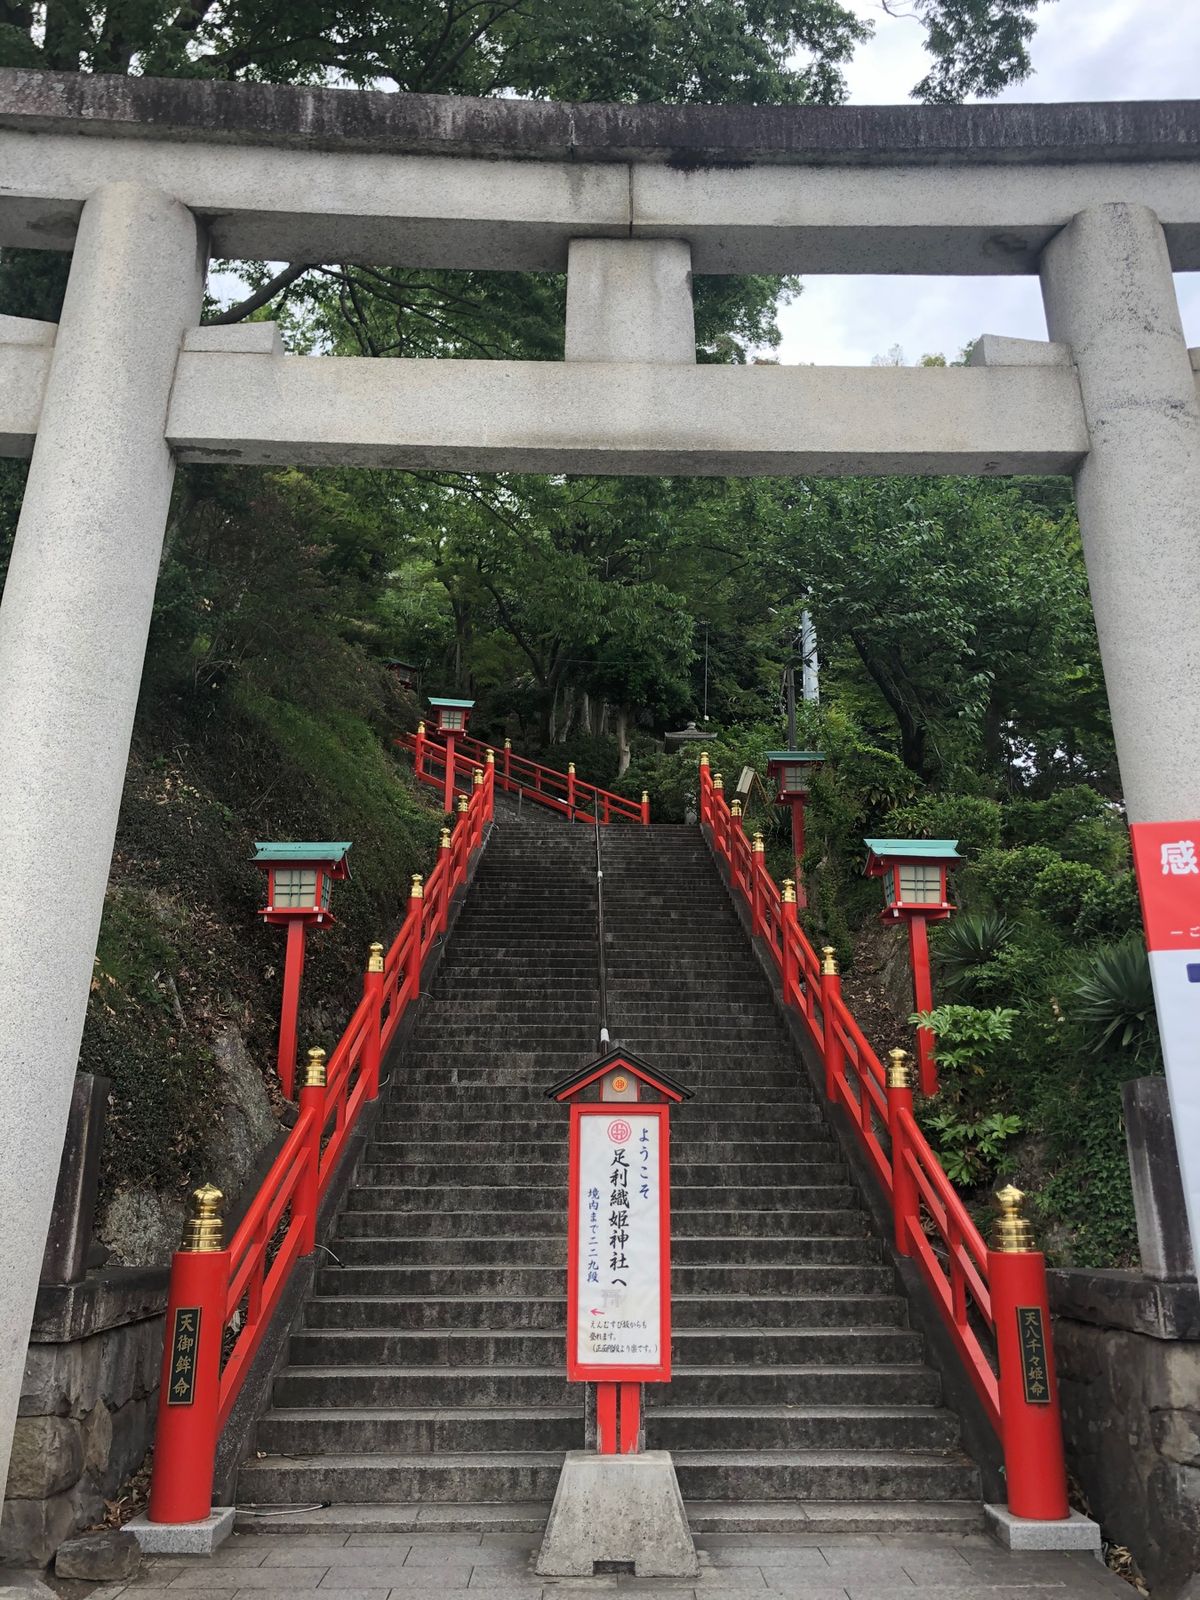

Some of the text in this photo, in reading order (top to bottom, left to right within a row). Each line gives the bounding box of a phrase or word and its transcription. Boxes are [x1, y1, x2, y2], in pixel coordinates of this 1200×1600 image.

[1161, 840, 1199, 875] 感
[639, 1128, 650, 1199] ようこそ
[587, 1187, 600, 1283] 境内まで二二九段
[609, 1148, 630, 1287] 足利織姫神社へ
[173, 1313, 194, 1397] 天御鉾命
[1025, 1312, 1045, 1397] 天八千々姫命
